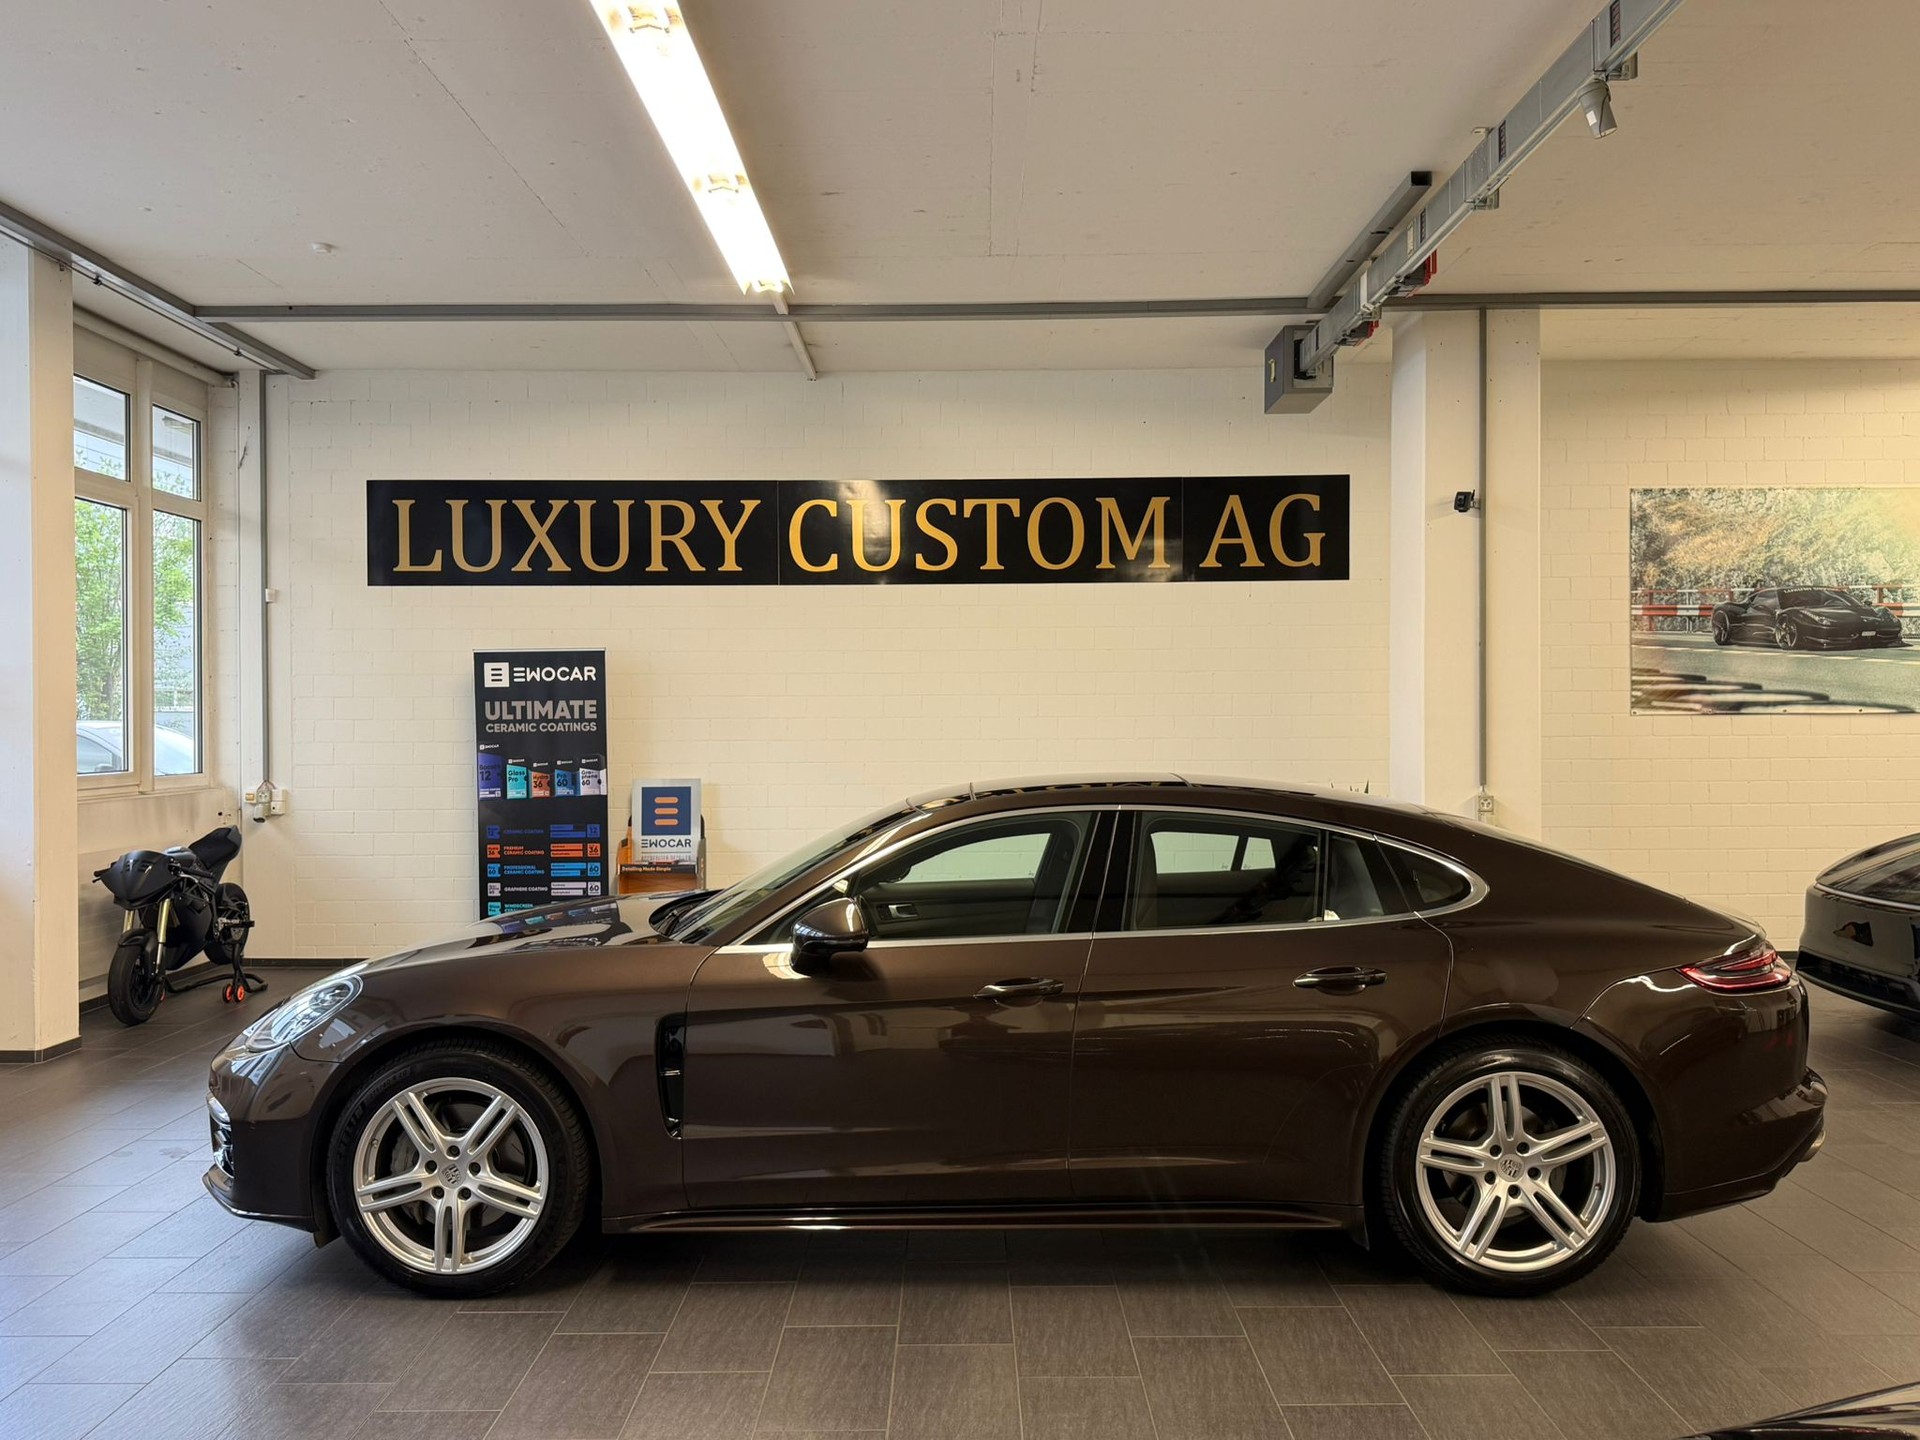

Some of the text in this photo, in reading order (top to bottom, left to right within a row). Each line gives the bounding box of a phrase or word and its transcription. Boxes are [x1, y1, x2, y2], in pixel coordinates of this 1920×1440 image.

[392, 493, 1326, 573] LUXURY CUSTOM AG
[513, 666, 597, 682] EWOCAR
[485, 699, 598, 721] ULTIMATE
[486, 721, 597, 733] CERAMIC COATINGS
[480, 770, 491, 781] 12
[533, 780, 543, 788] 36
[557, 779, 568, 787] 60
[641, 838, 692, 849] EWOCAR
